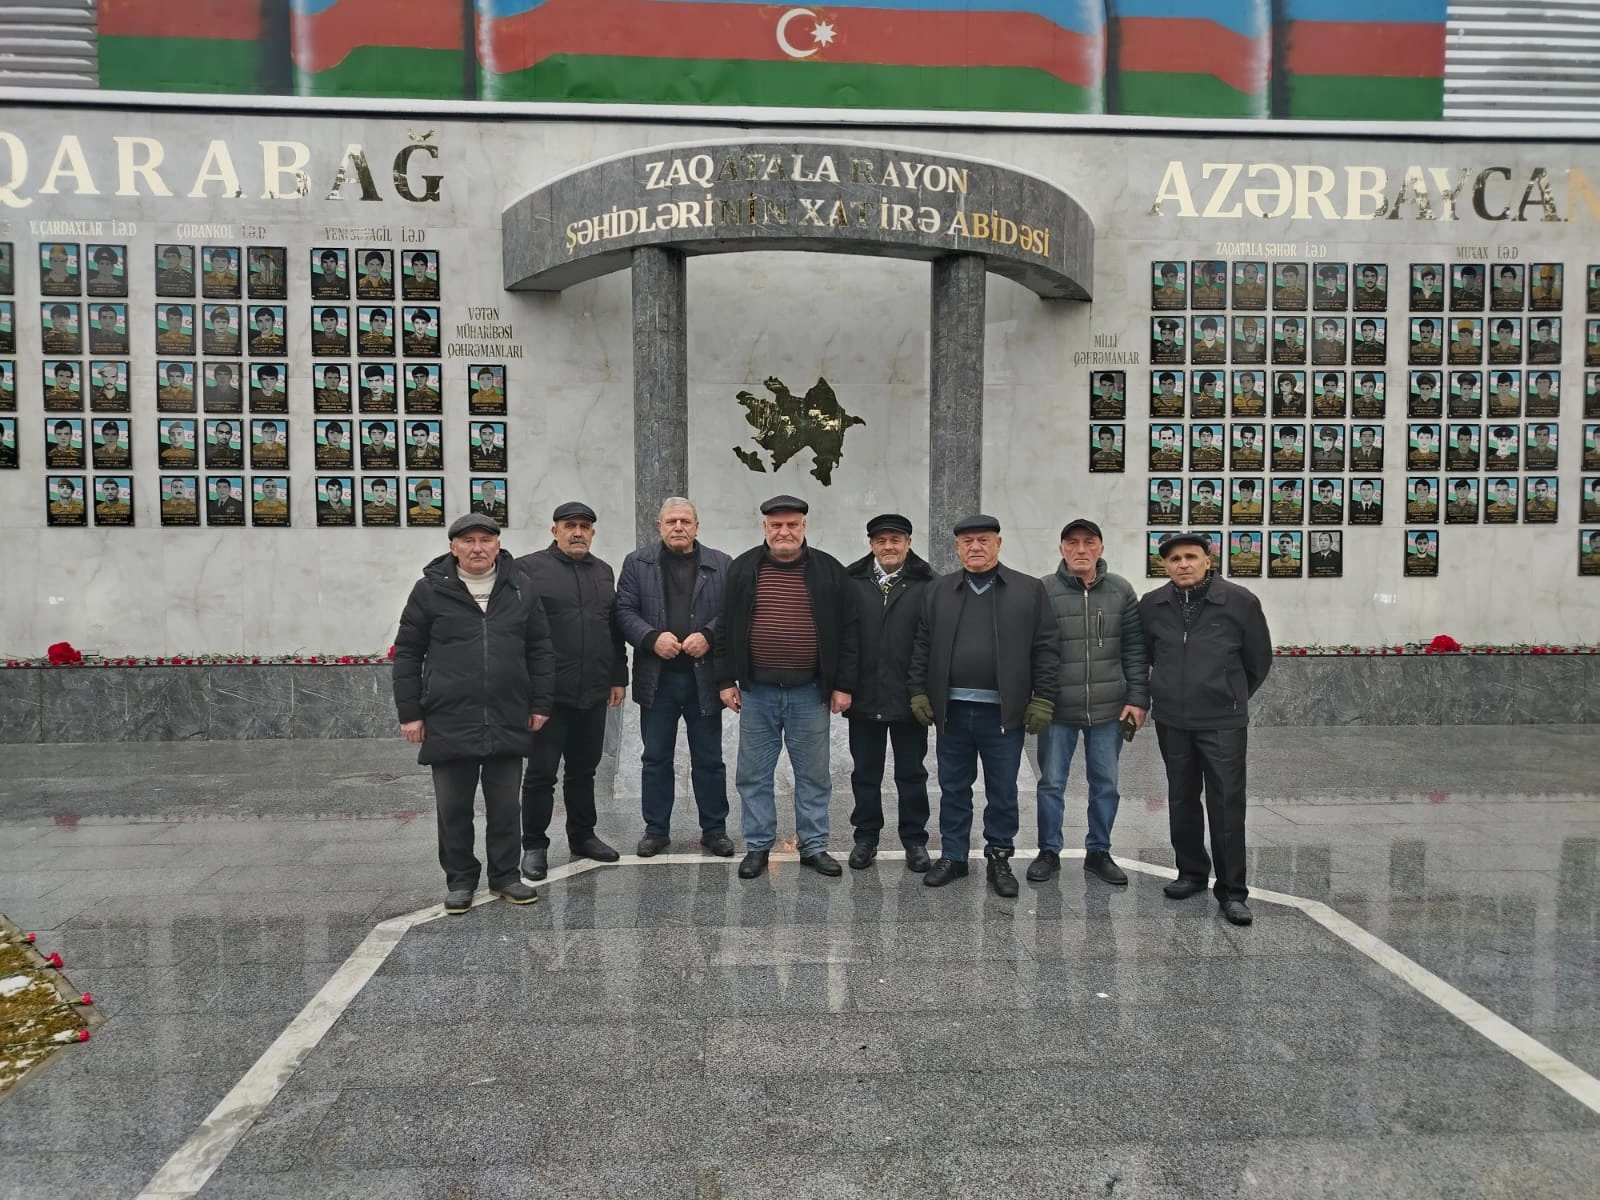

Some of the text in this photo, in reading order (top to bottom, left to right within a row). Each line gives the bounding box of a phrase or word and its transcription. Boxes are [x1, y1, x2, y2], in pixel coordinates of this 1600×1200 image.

[646, 153, 969, 195] ZAQATALA RAYON
[566, 192, 1051, 258] ŞƏHİDLƏRİNİN XATİRƏ ABİDƏSİ
[1215, 241, 1263, 257] ZAQATALA
[468, 307, 500, 321] VƏTƏN
